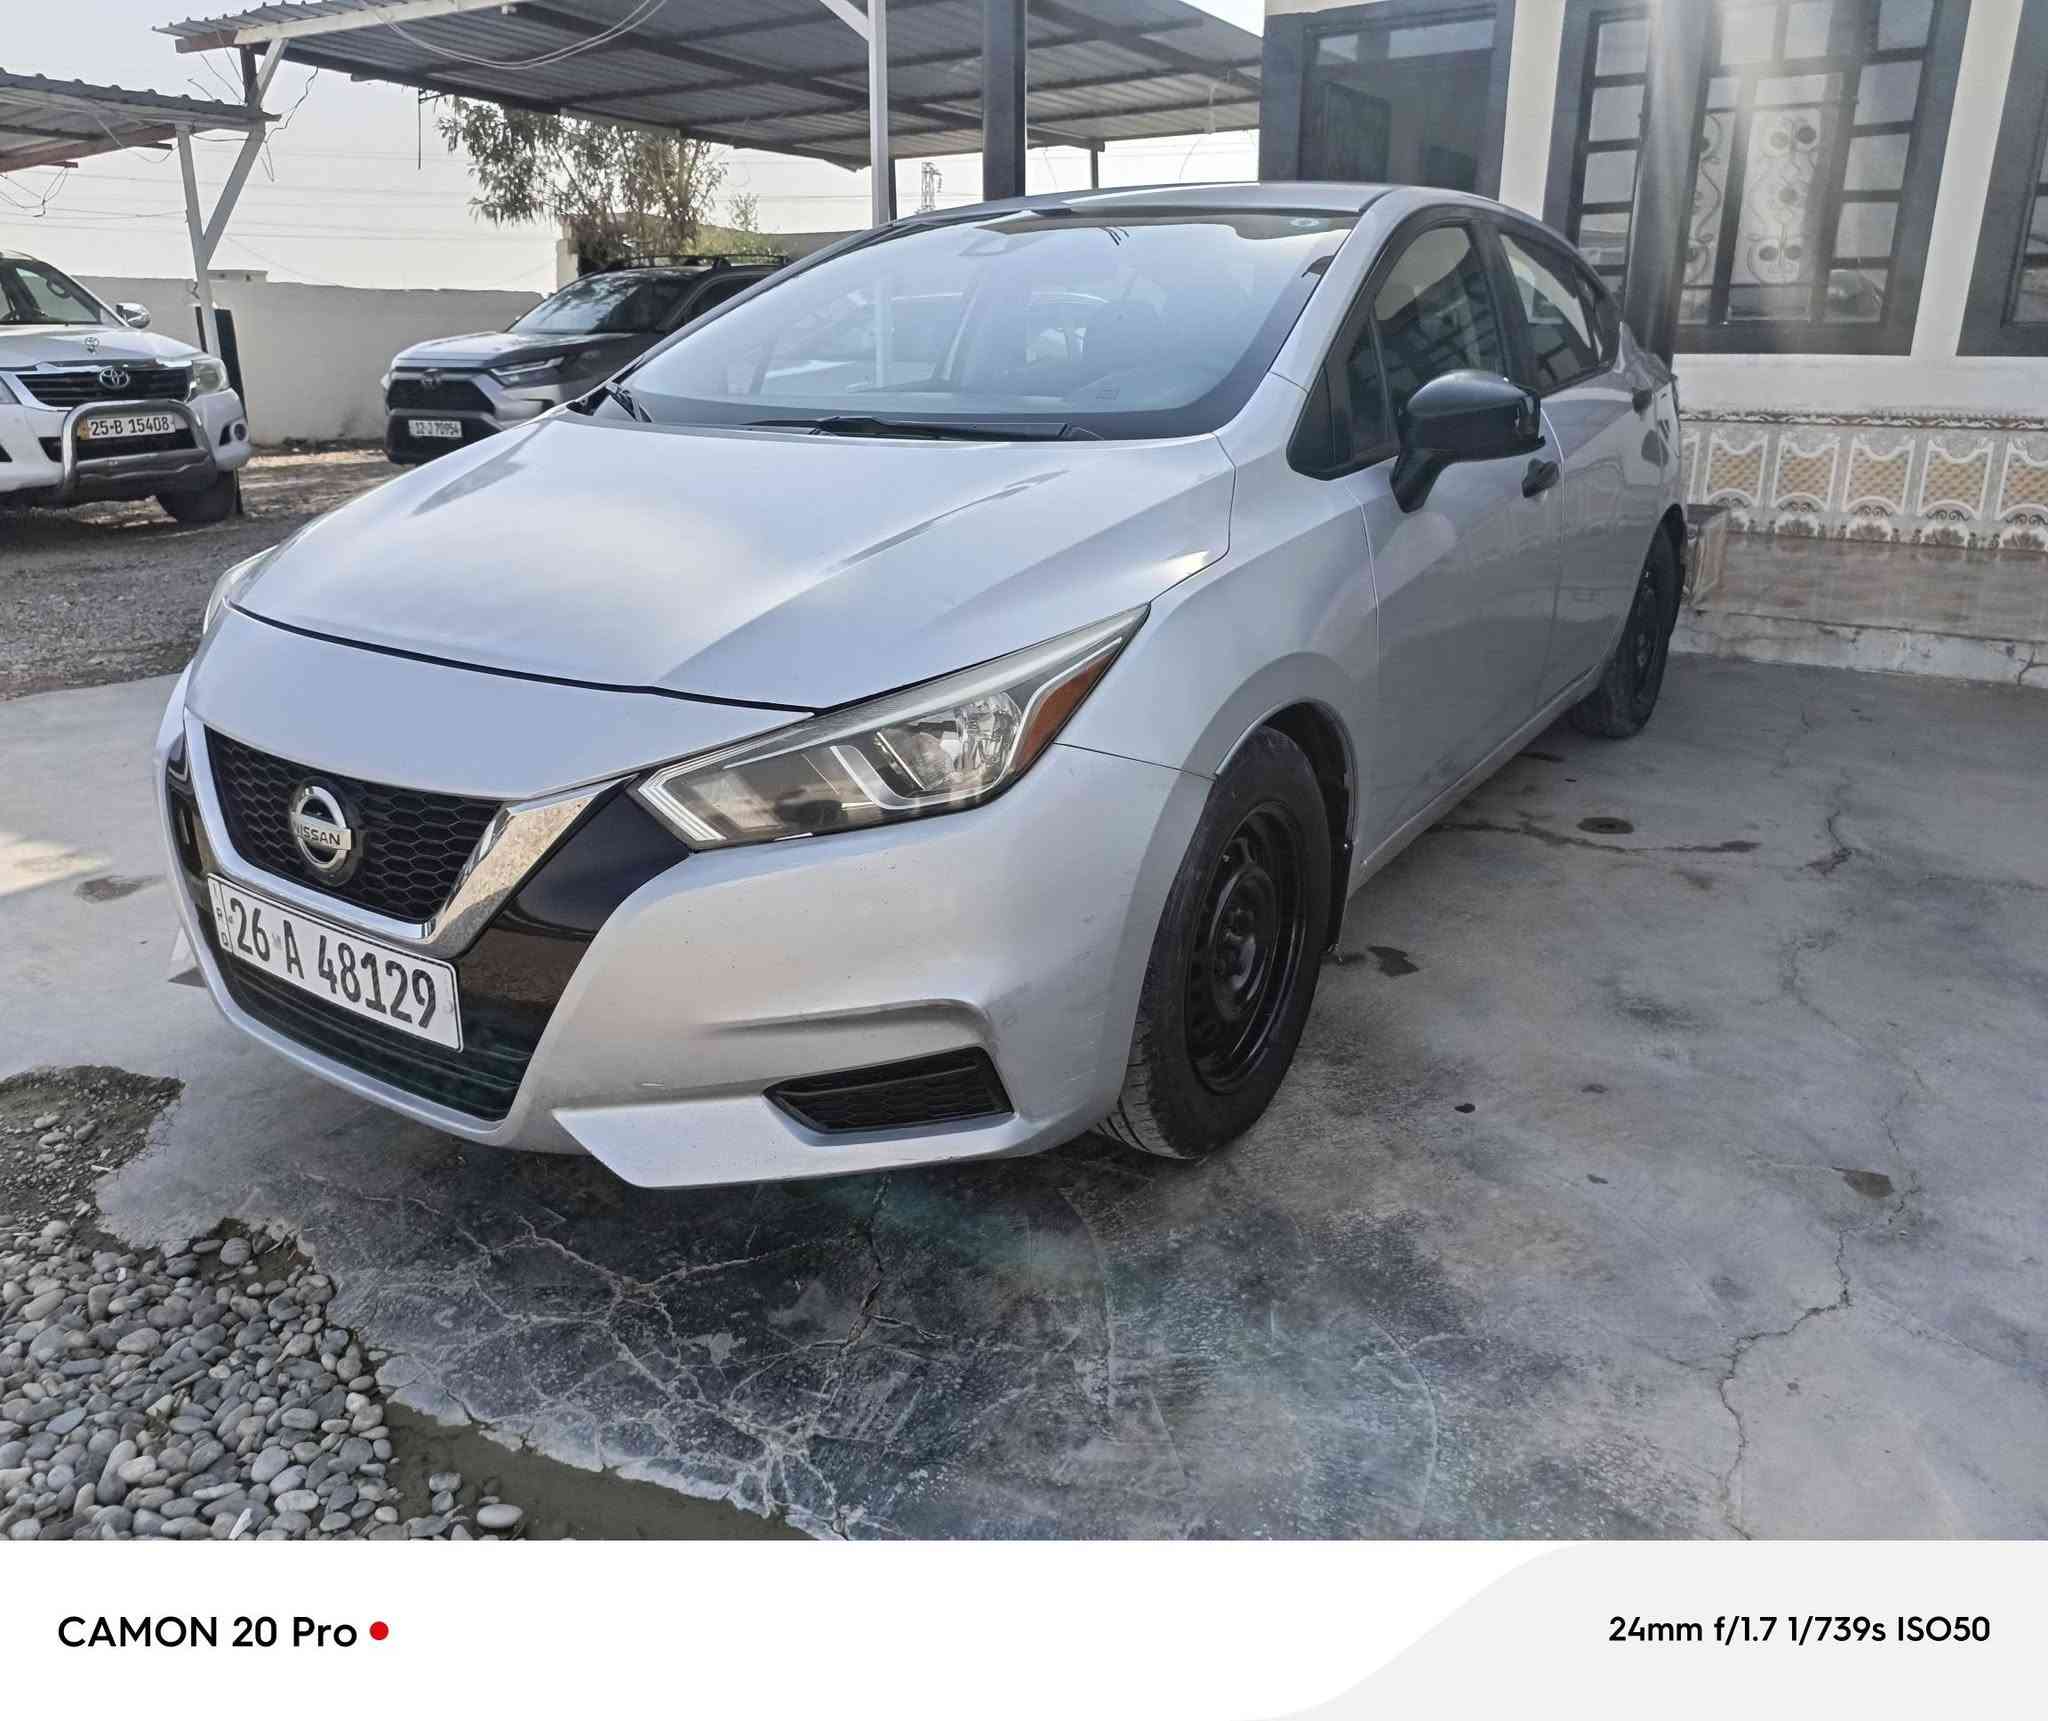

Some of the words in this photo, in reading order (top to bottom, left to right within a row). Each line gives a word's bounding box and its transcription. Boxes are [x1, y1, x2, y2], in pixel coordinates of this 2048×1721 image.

[128, 416, 170, 433] 15408
[230, 897, 271, 962] 26
[283, 919, 305, 980] A
[317, 934, 437, 1030] 48129
